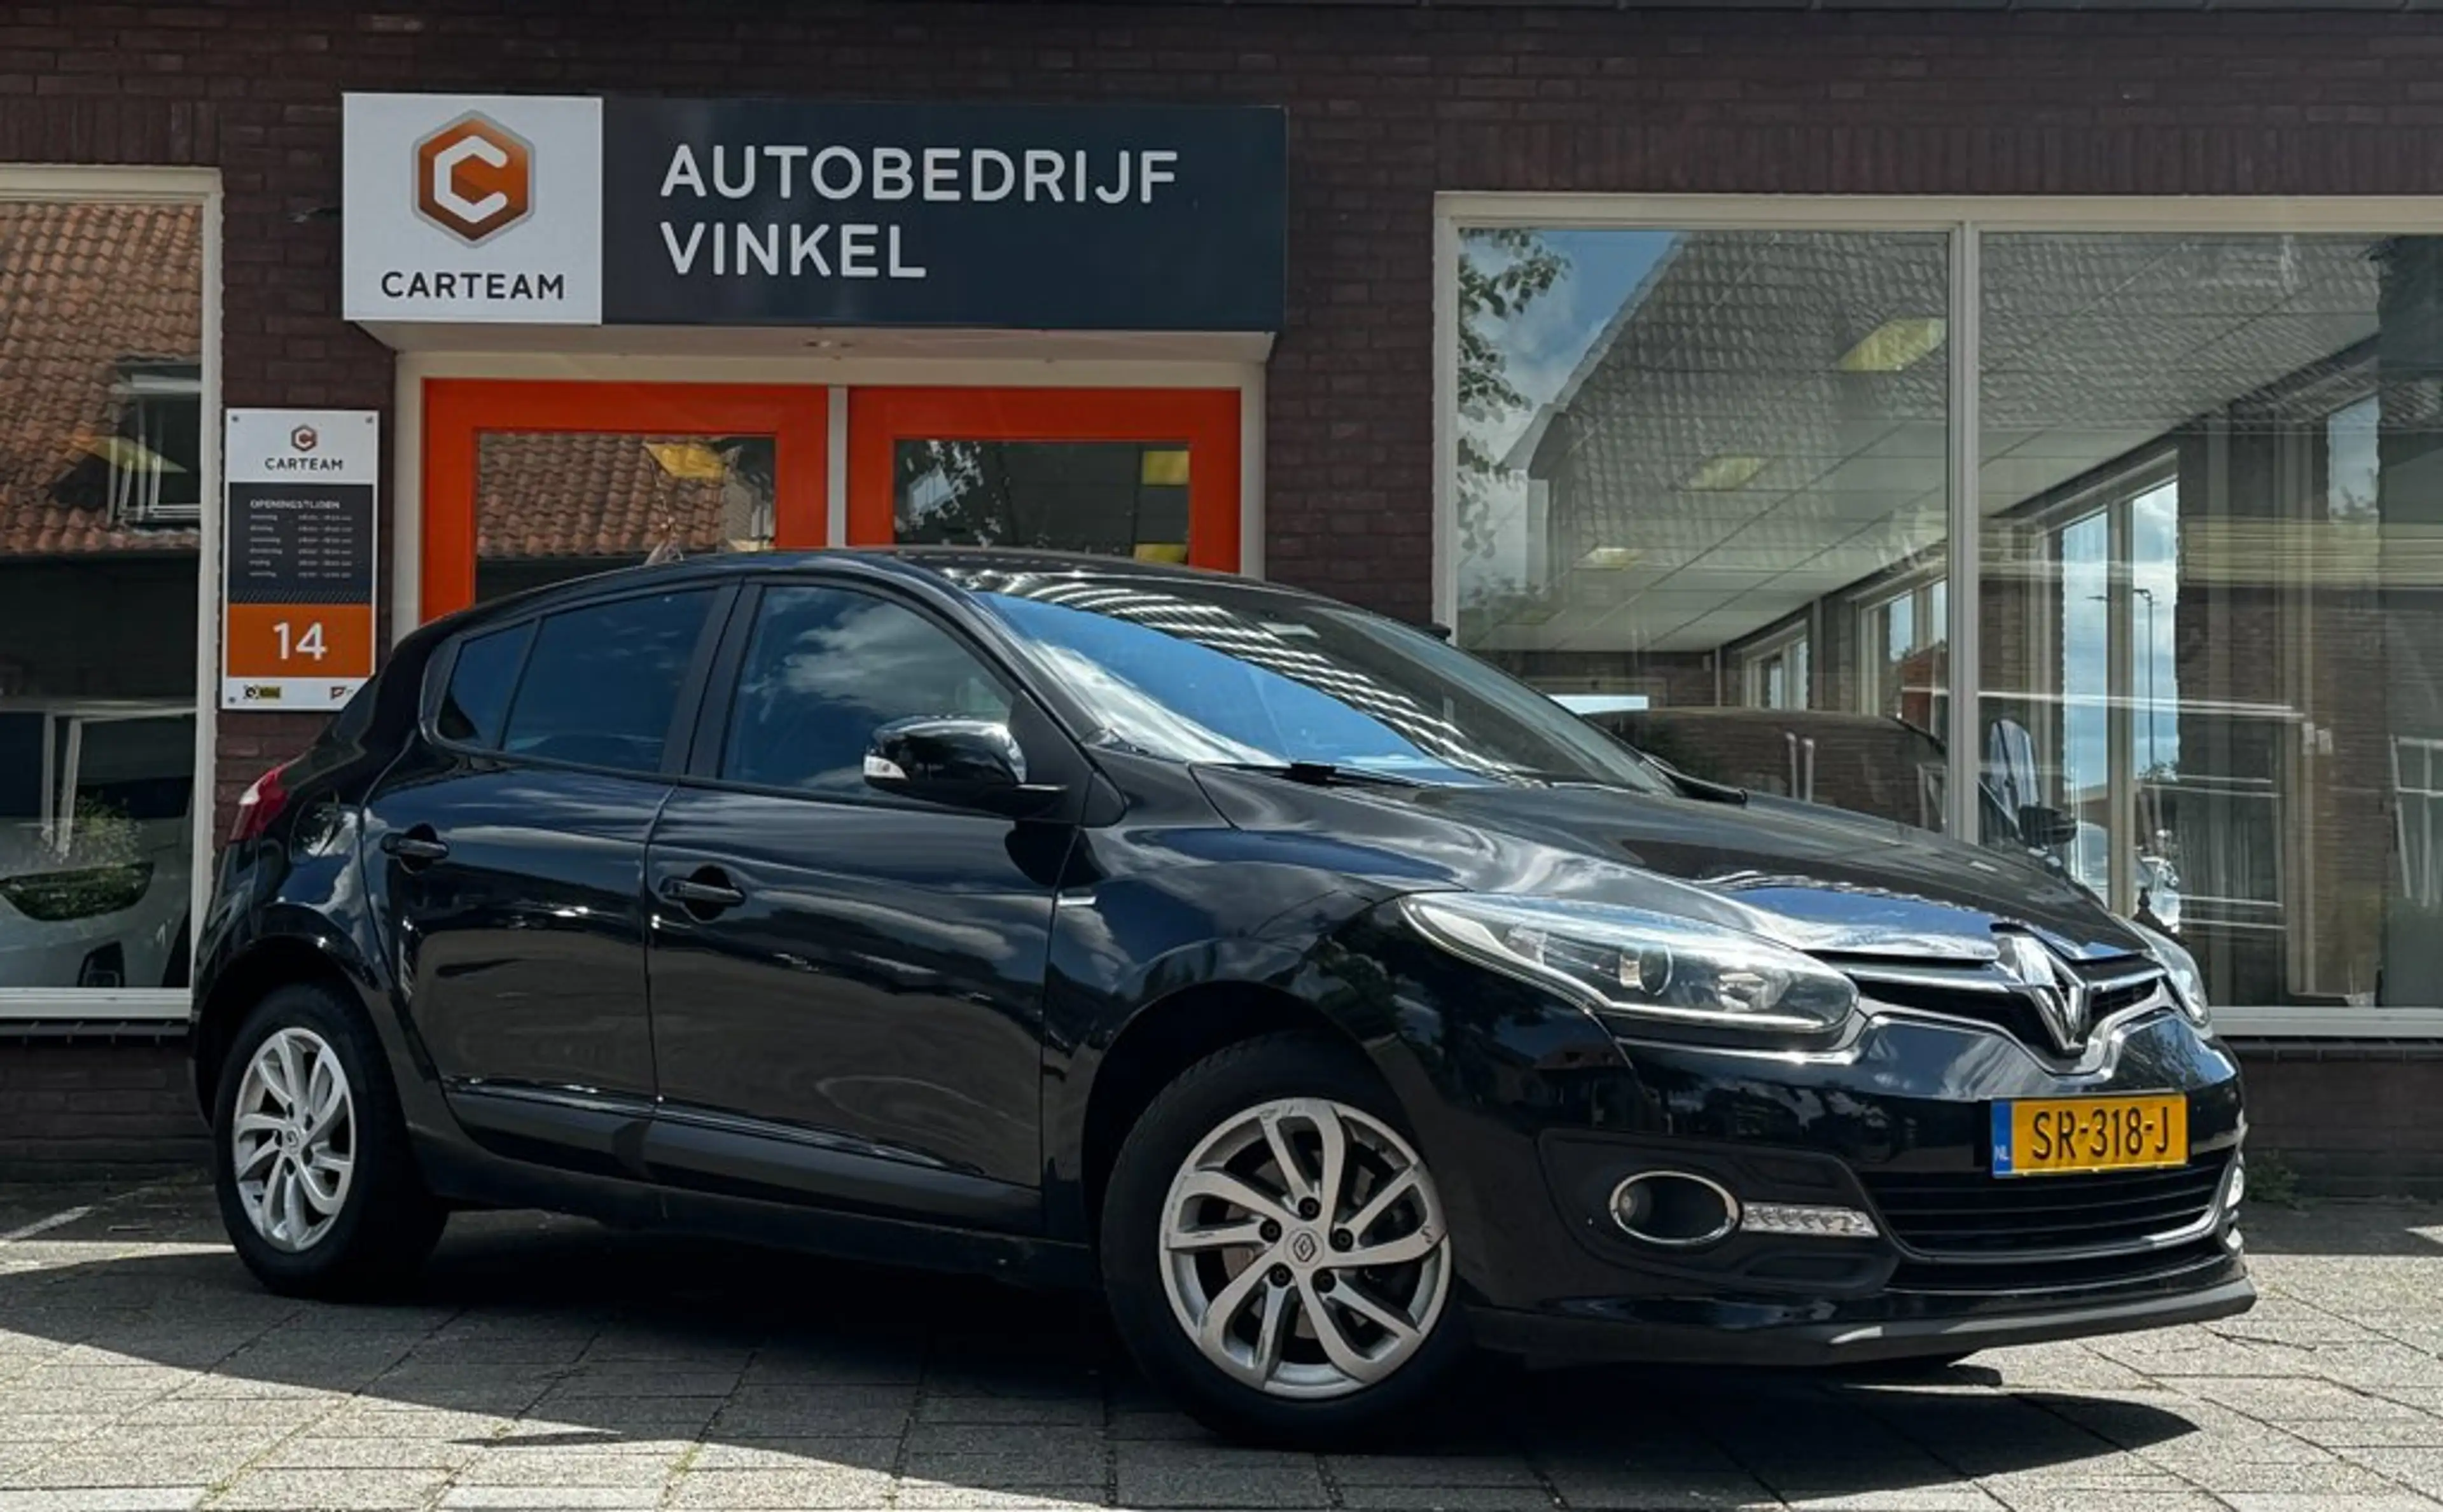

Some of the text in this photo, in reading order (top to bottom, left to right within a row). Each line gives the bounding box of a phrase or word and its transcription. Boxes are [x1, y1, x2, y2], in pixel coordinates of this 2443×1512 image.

[660, 144, 1178, 204] AUTOBEDRIJF
[660, 221, 927, 278] VINKEL
[381, 271, 565, 300] CARTEAM
[264, 458, 343, 470] CARTEAM
[273, 622, 327, 660] 14
[2031, 1106, 2169, 1160] SR-318-J
[1993, 1144, 2009, 1162] NL
